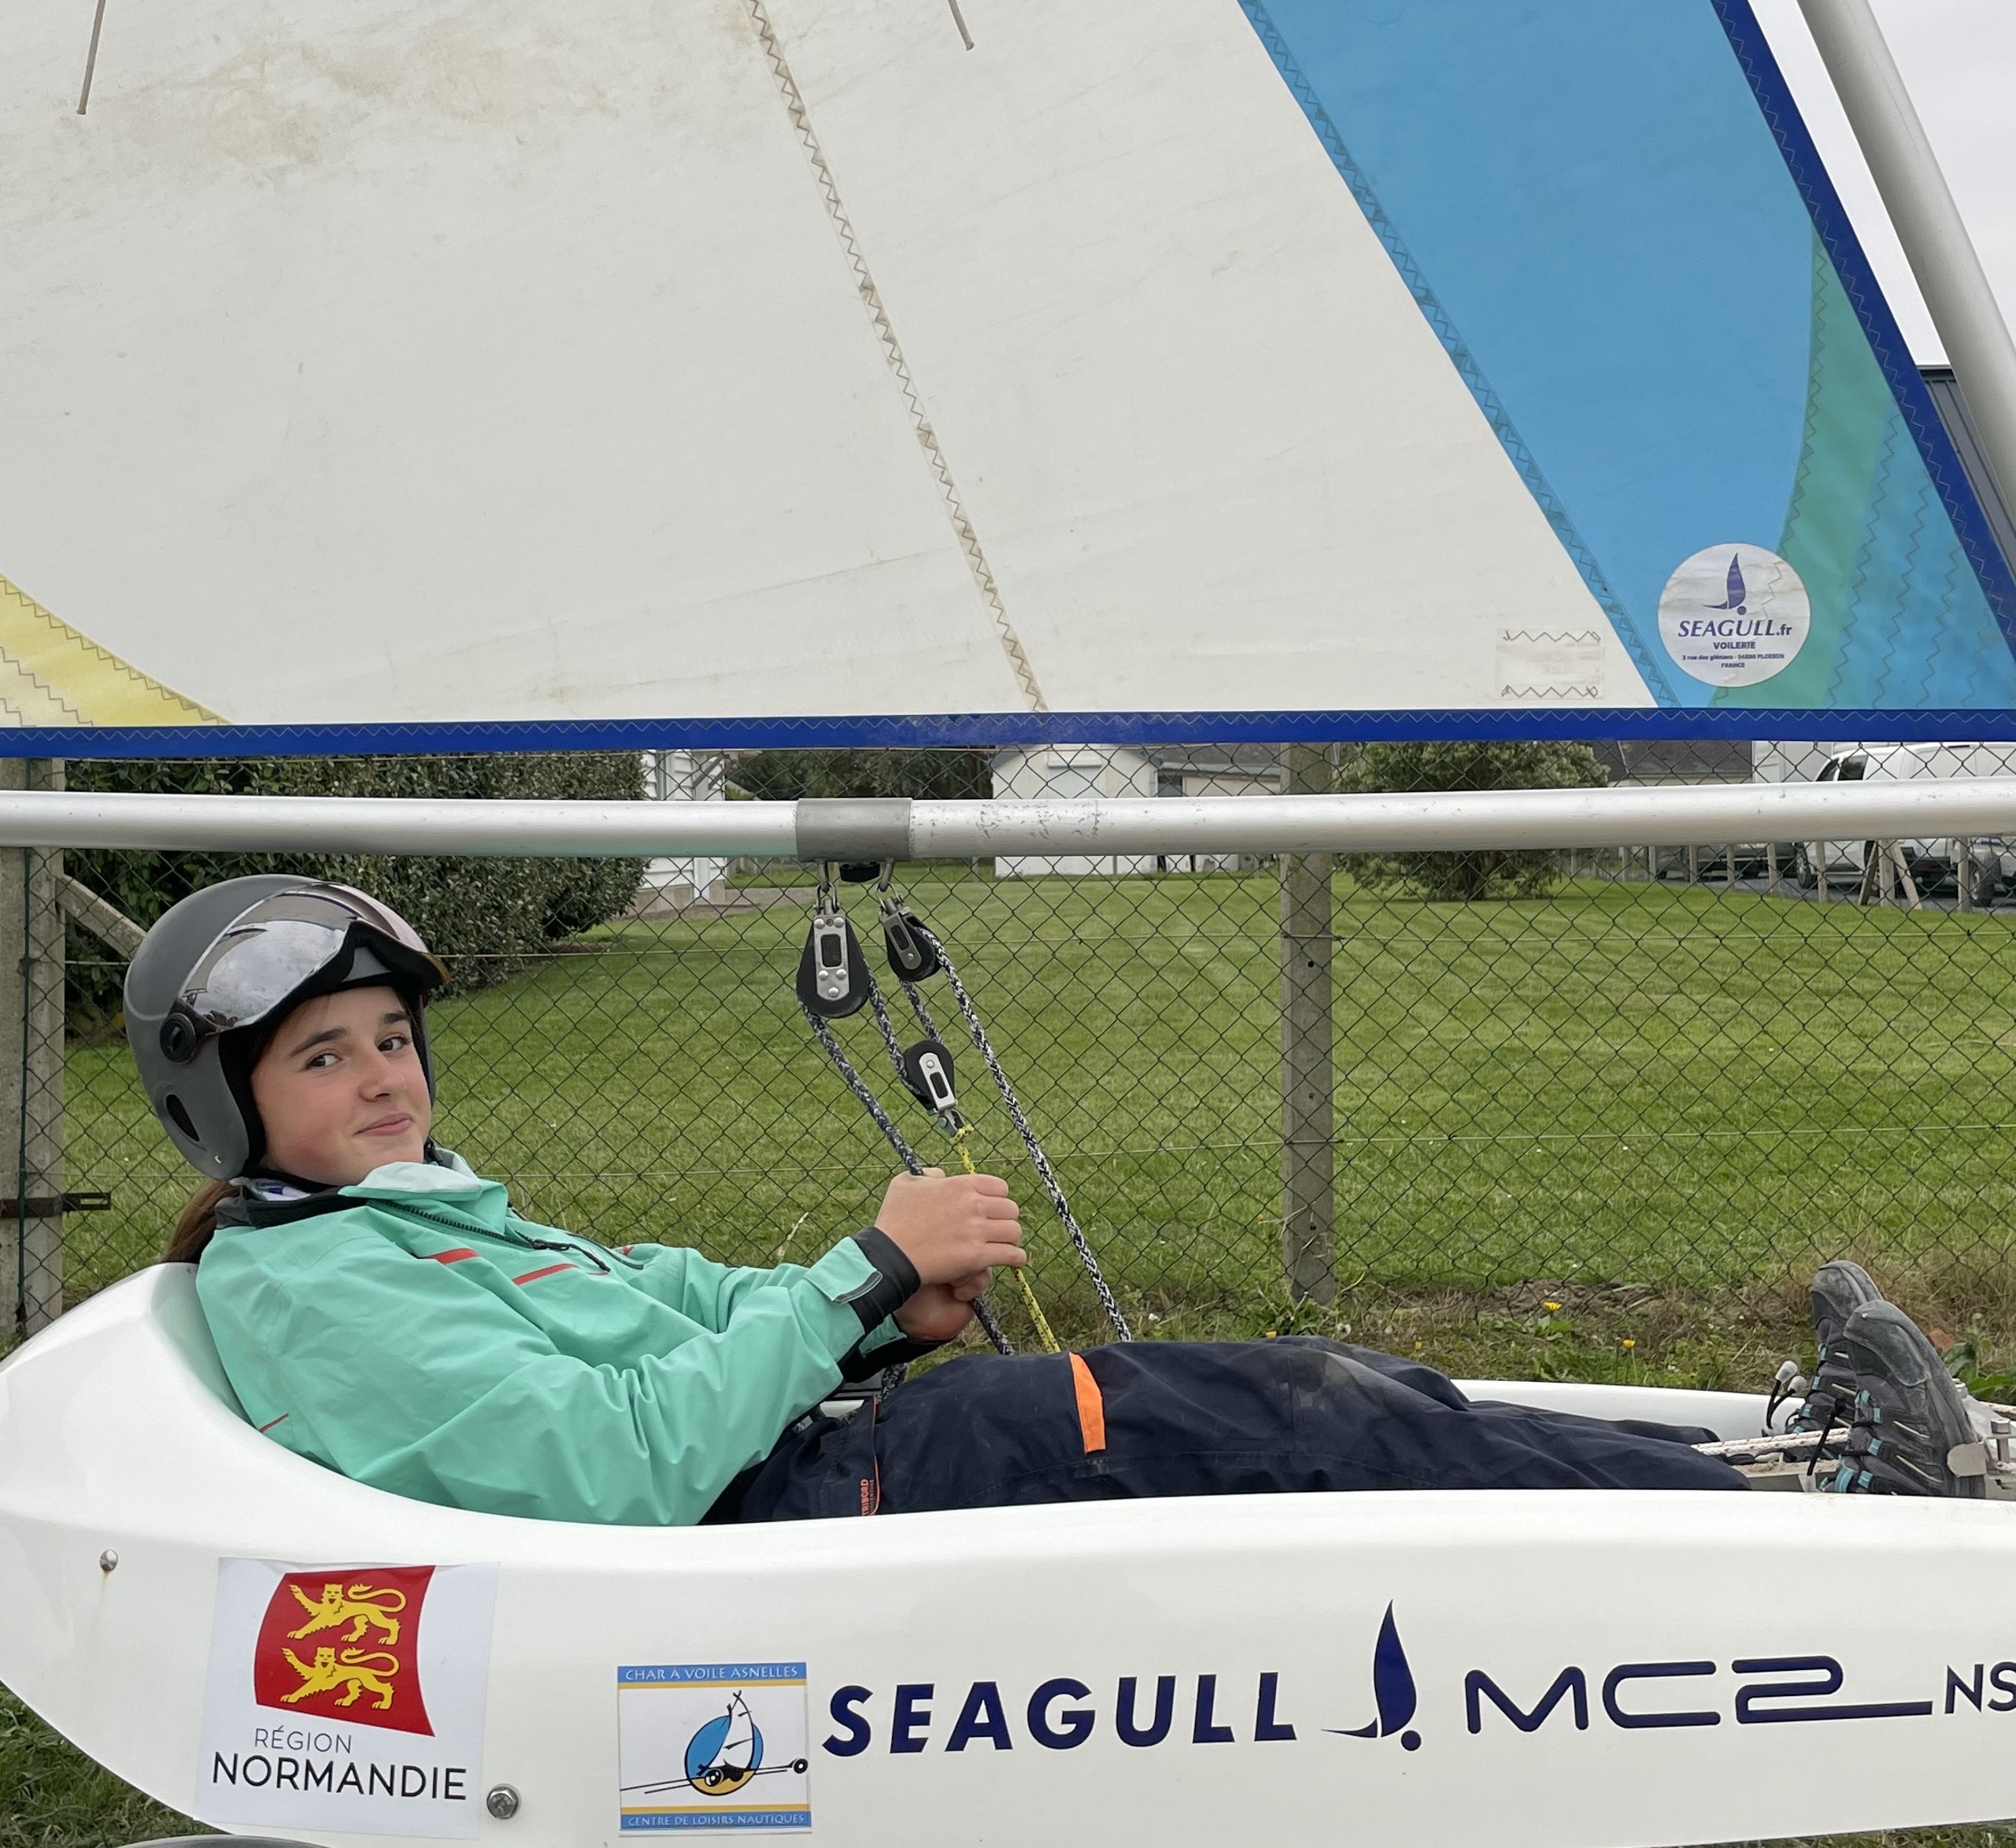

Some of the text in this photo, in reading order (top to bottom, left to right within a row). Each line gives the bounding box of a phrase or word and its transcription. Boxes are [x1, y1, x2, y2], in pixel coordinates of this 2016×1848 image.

[1713, 641, 1755, 650] VOILERIE
[625, 1668, 666, 1681] CHAR
[685, 1667, 726, 1679] VOILE
[731, 1665, 798, 1679] ASNELLES
[821, 1672, 1297, 1757] SEAGULL
[253, 1725, 352, 1754] RÉGION
[213, 1751, 467, 1801] NORMANDIE
[628, 1813, 805, 1828] CENTRE DE LOISIRS NAUTIQUES
